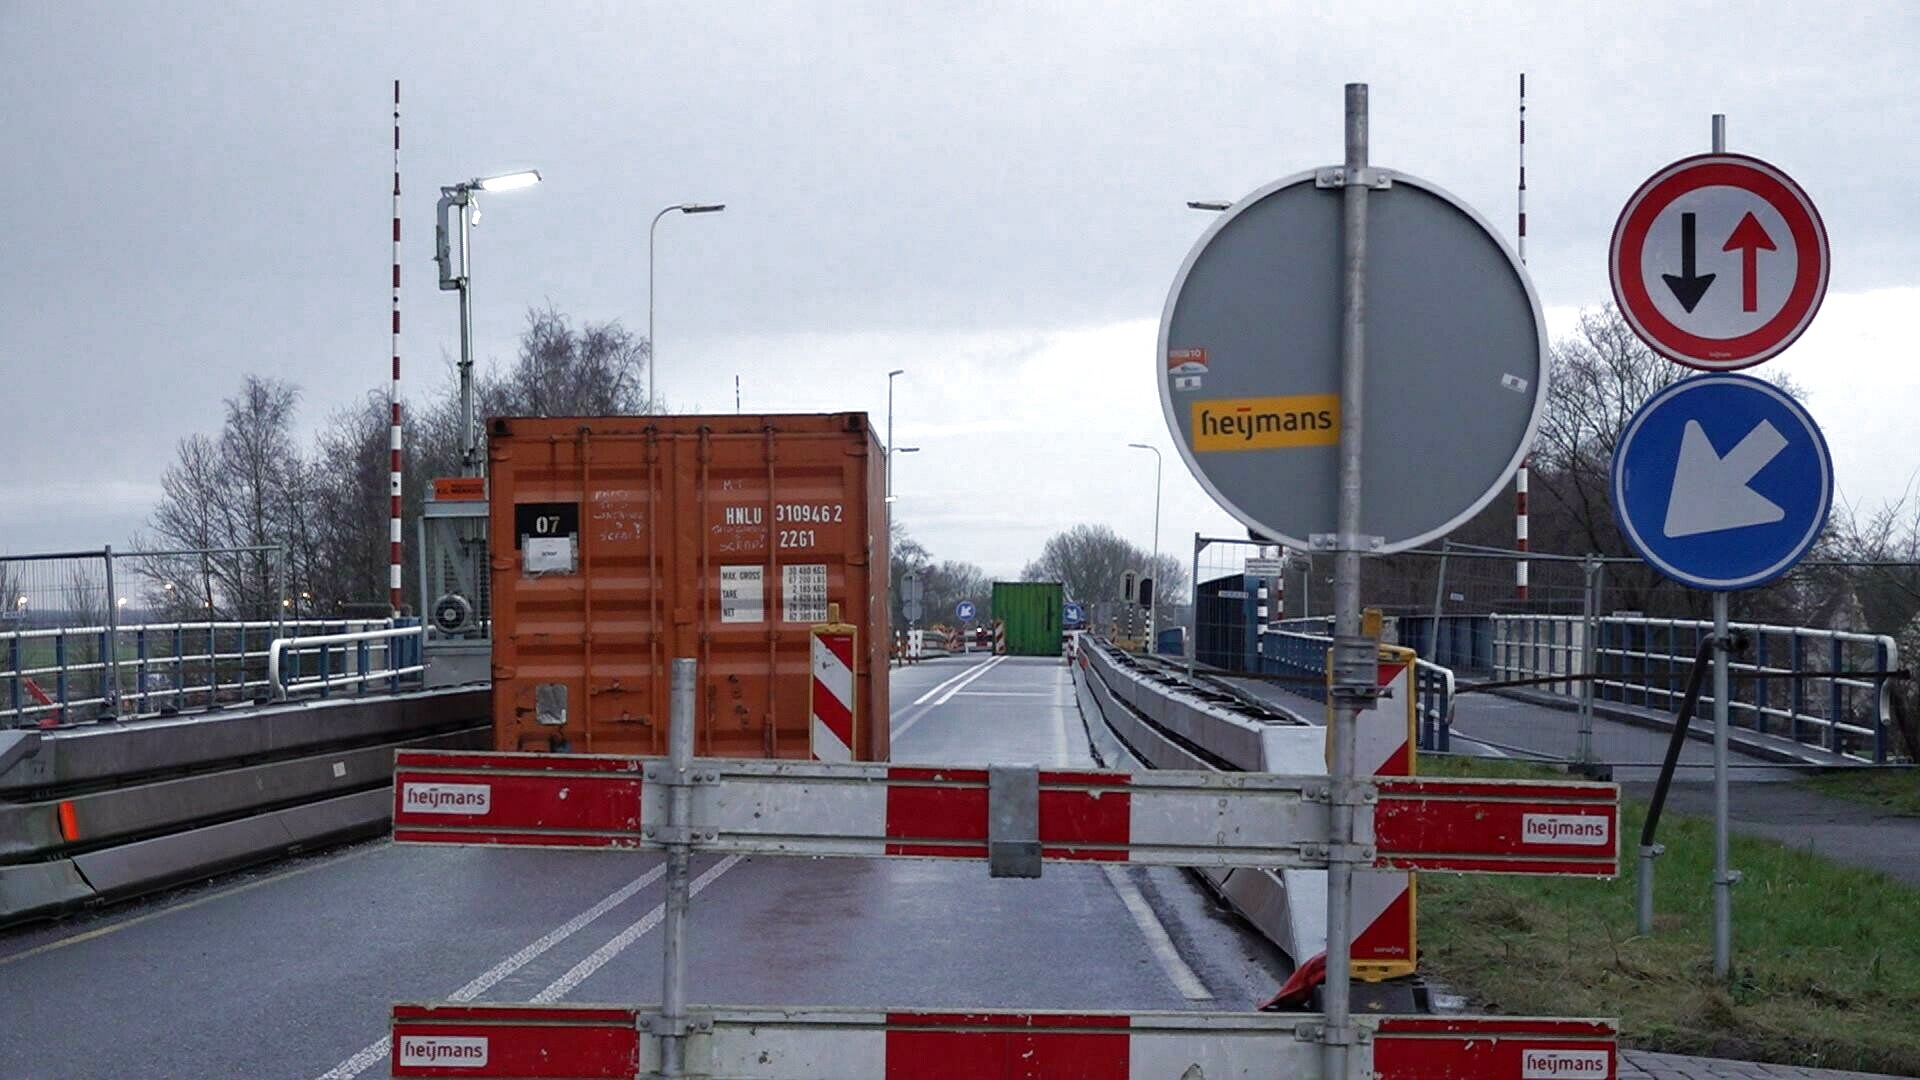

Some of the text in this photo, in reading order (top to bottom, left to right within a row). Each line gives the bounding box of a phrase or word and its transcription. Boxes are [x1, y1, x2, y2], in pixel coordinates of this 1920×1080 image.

[1201, 407, 1332, 441] heijmans
[536, 516, 560, 534] 07
[726, 507, 762, 525] HNLU
[739, 571, 760, 580] GROSS
[722, 589, 738, 598] TARE
[723, 607, 735, 617] NET
[407, 787, 485, 808] heijmans
[1527, 818, 1604, 839] heijmans
[405, 1040, 483, 1061] heijmans
[1527, 1053, 1603, 1074] heijmans
